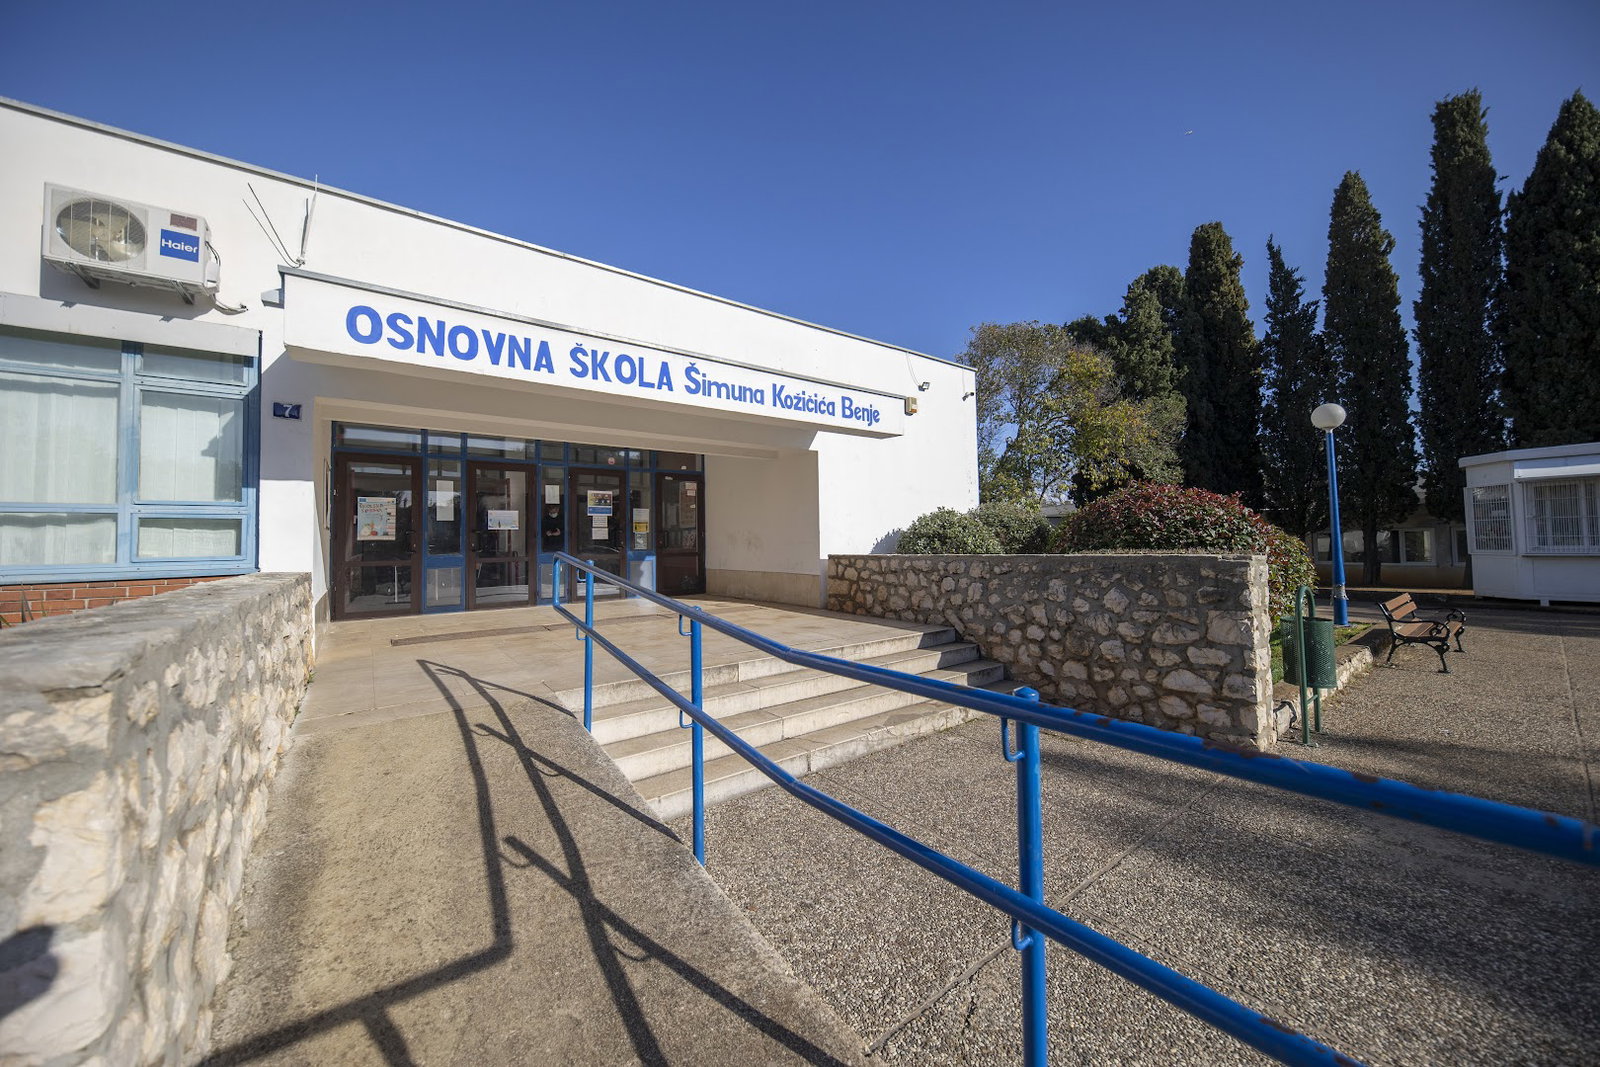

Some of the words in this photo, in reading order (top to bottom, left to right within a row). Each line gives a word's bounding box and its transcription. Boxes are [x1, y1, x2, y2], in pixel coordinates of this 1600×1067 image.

[161, 238, 198, 253] Haier
[346, 305, 555, 374] OSNOVNA
[569, 342, 674, 392] ŠKOLA
[684, 362, 765, 406] Šimuna
[772, 383, 835, 416] Kožičića
[841, 396, 880, 427] Benje
[283, 404, 293, 418] 7
